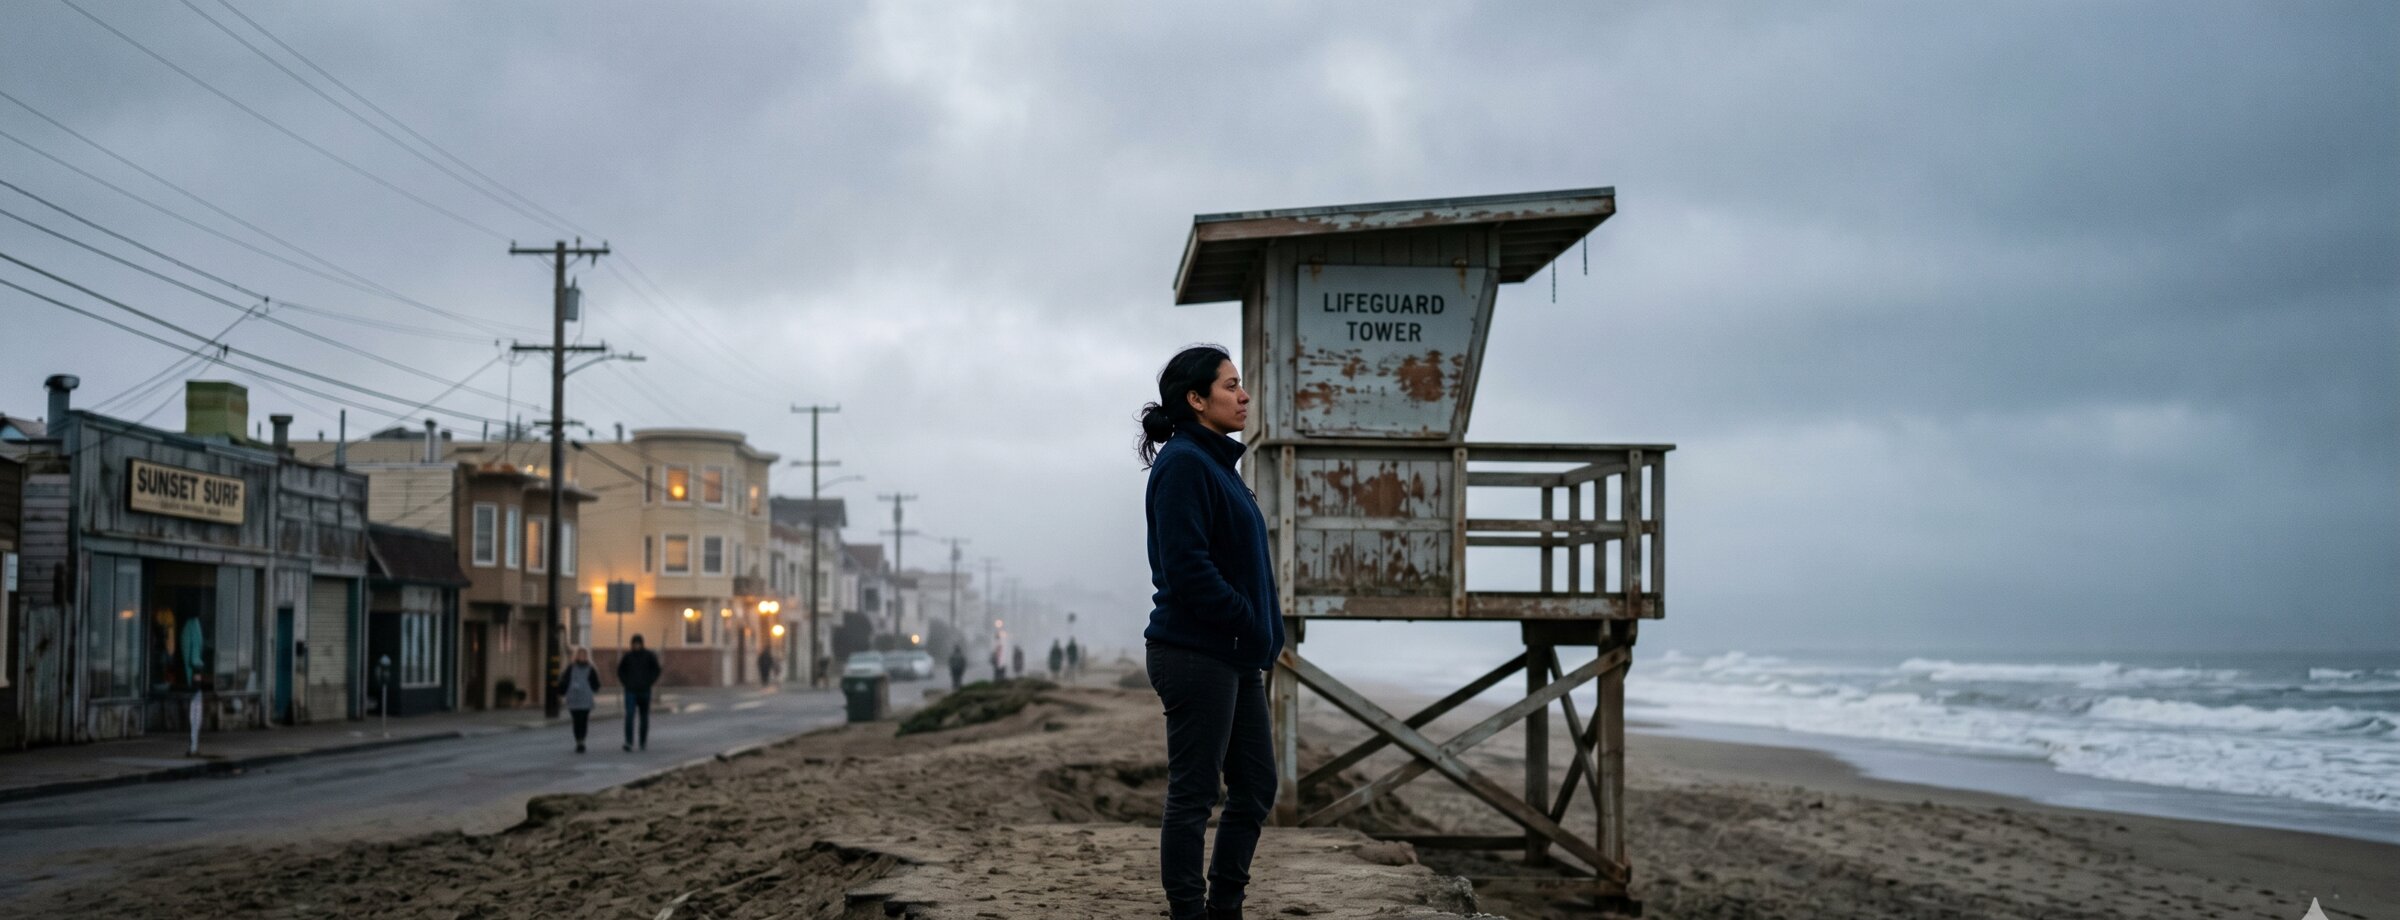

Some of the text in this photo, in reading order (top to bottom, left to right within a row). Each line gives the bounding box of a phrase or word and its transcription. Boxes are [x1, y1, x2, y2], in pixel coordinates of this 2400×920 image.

[1324, 293, 1445, 314] LIFEGUARD
[1346, 321, 1422, 341] TOWER
[137, 467, 239, 507] SUNSET SURF
